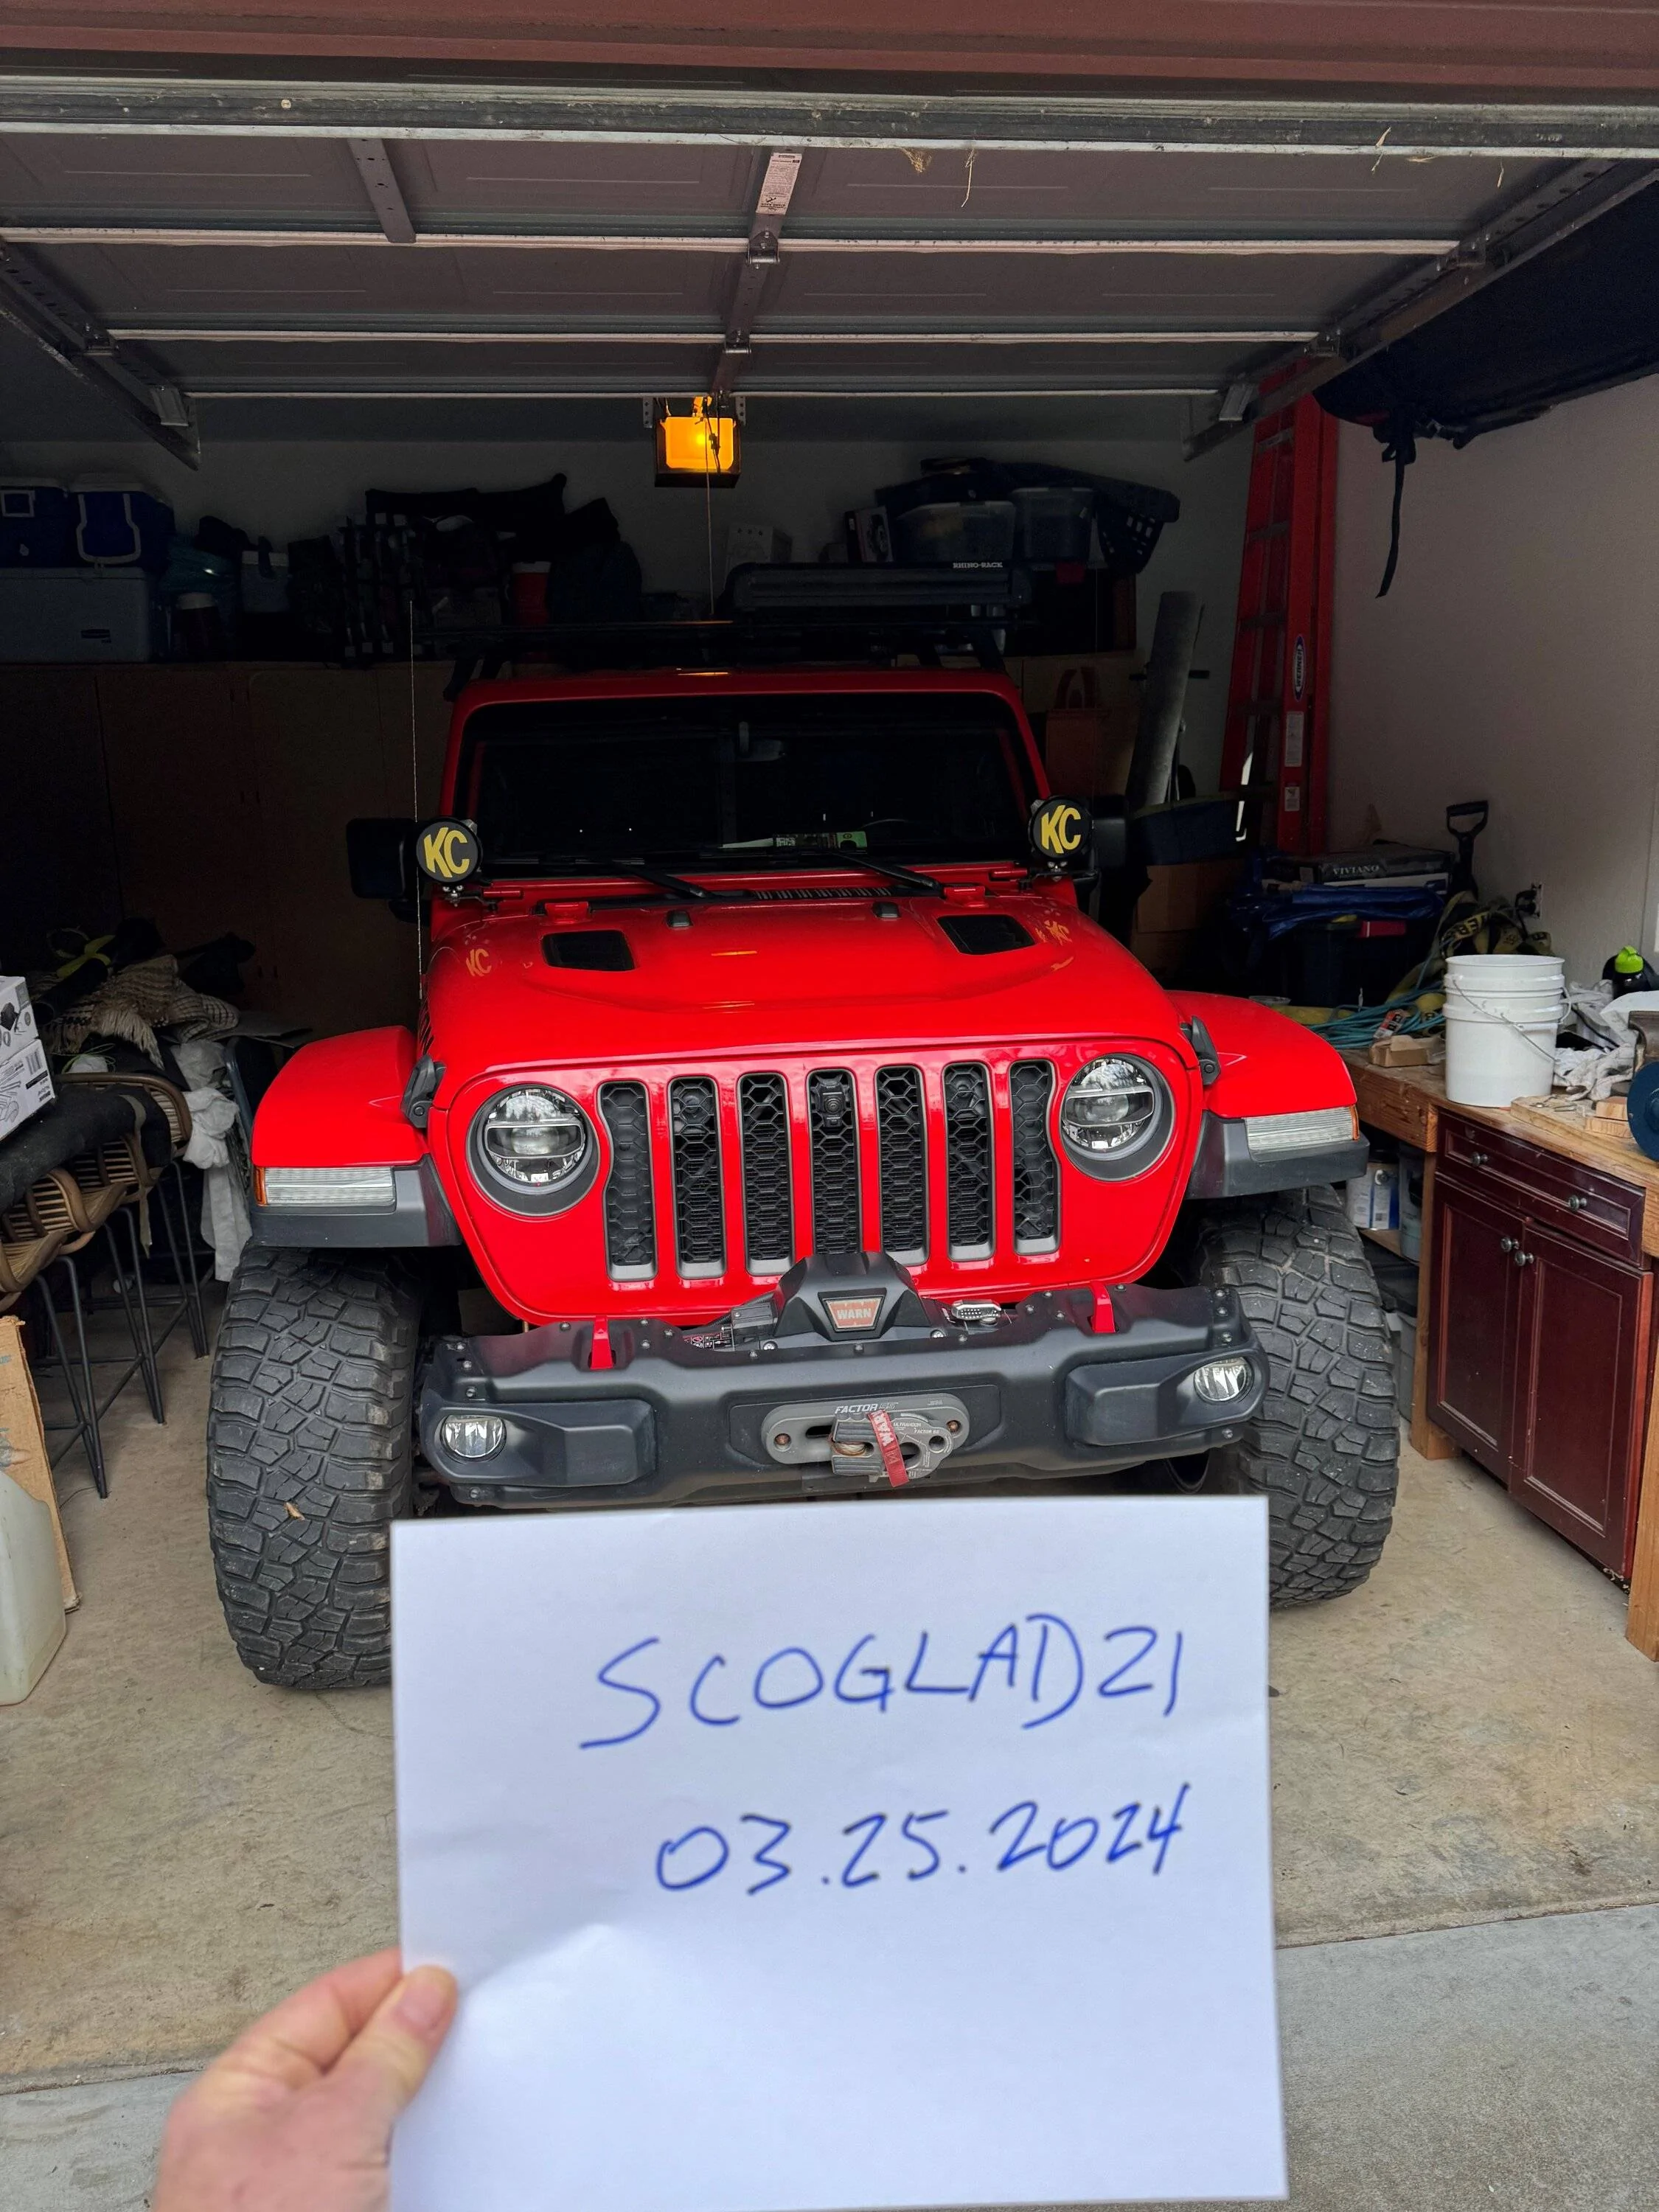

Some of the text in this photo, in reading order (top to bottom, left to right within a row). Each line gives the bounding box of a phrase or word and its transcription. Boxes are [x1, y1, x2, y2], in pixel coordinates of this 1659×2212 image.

[1041, 804, 1082, 855] KC
[423, 827, 470, 878] KC
[1332, 864, 1380, 876] VIVIANO
[837, 1308, 872, 1320] WARN
[835, 1403, 878, 1413] FACTOR
[655, 1783, 1191, 1895] 03.25.2024
